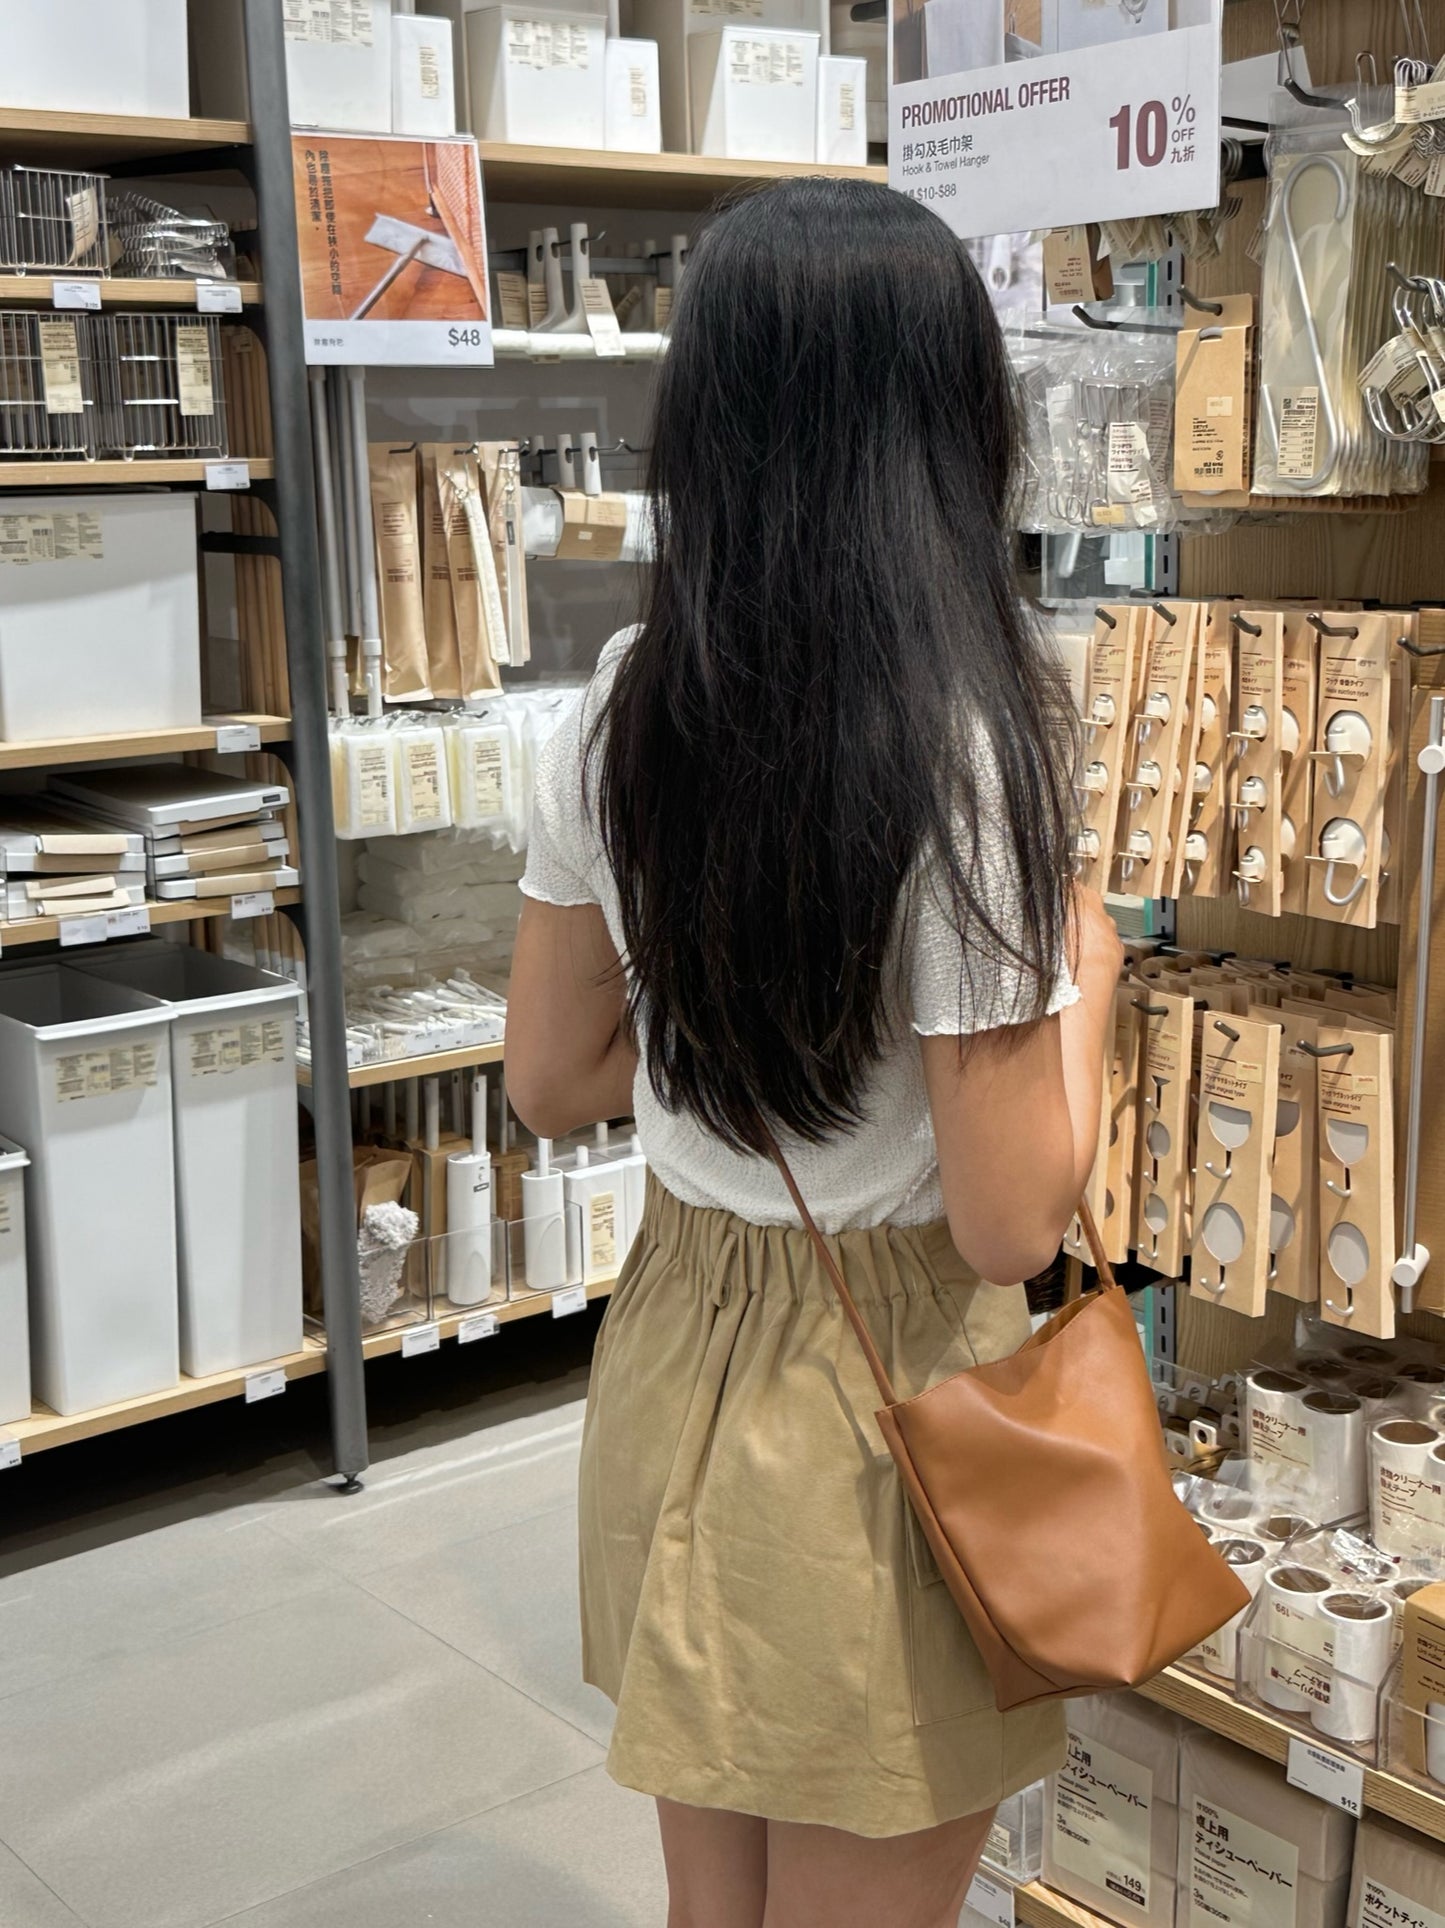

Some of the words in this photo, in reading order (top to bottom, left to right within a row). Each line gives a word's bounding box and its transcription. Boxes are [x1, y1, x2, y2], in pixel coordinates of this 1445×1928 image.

[902, 86, 1014, 128] PROMOTIONAL
[1018, 76, 1070, 108] OFFER
[1109, 100, 1167, 170] 10
[1171, 128, 1195, 143] OFF
[902, 135, 973, 162] 掛勾及毛巾架
[1170, 146, 1195, 164] 九折
[902, 161, 924, 176] Hook
[925, 160, 932, 173] &
[934, 157, 957, 172] Towel
[959, 153, 990, 171] Hanger
[448, 327, 481, 347] $48
[1341, 1796, 1358, 1811] $12
[1123, 1874, 1142, 1892] 149
